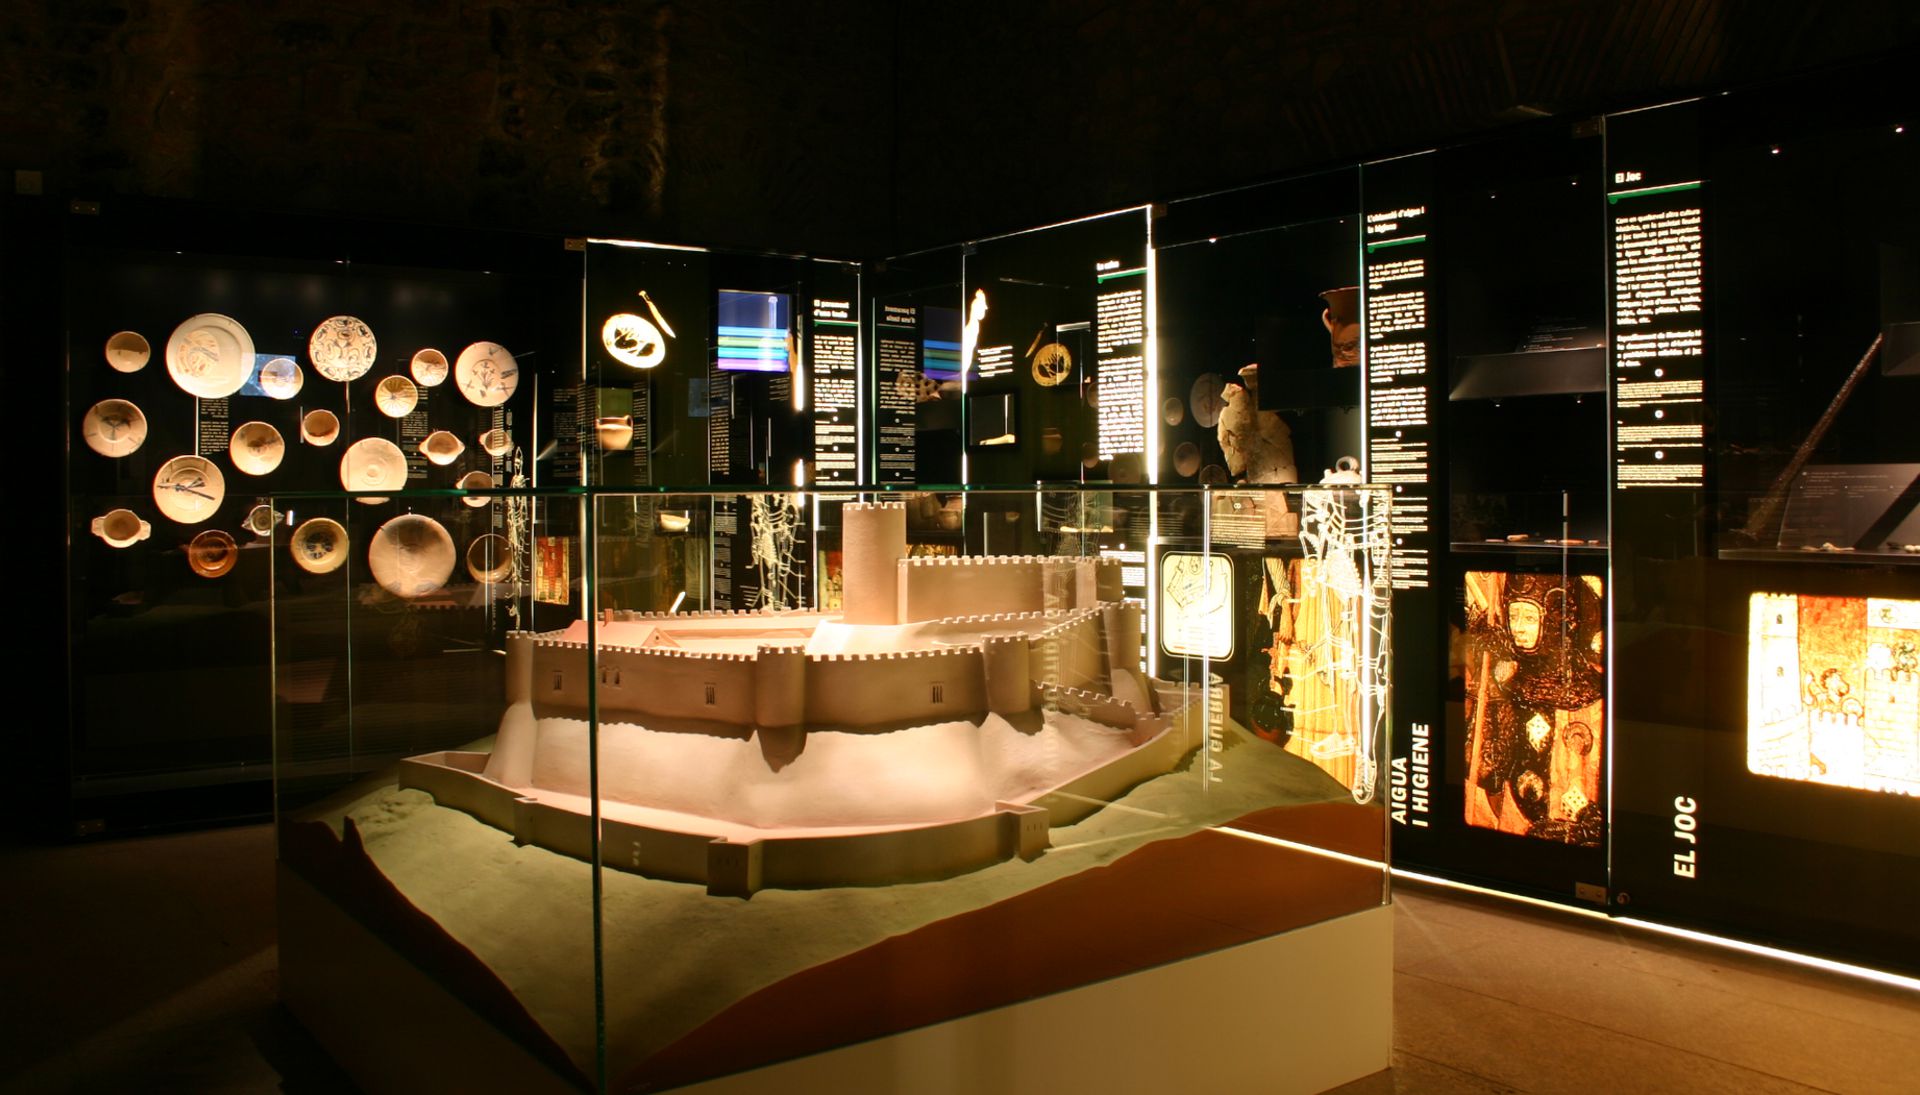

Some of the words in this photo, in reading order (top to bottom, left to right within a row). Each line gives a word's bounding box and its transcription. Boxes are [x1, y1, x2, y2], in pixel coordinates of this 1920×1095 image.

[1615, 173, 1624, 183] El
[1411, 722, 1429, 812] HIGIENE
[1391, 757, 1407, 825] AIGUA
[1412, 819, 1428, 827] I
[1674, 795, 1697, 844] JOC
[1673, 849, 1696, 878] EL
